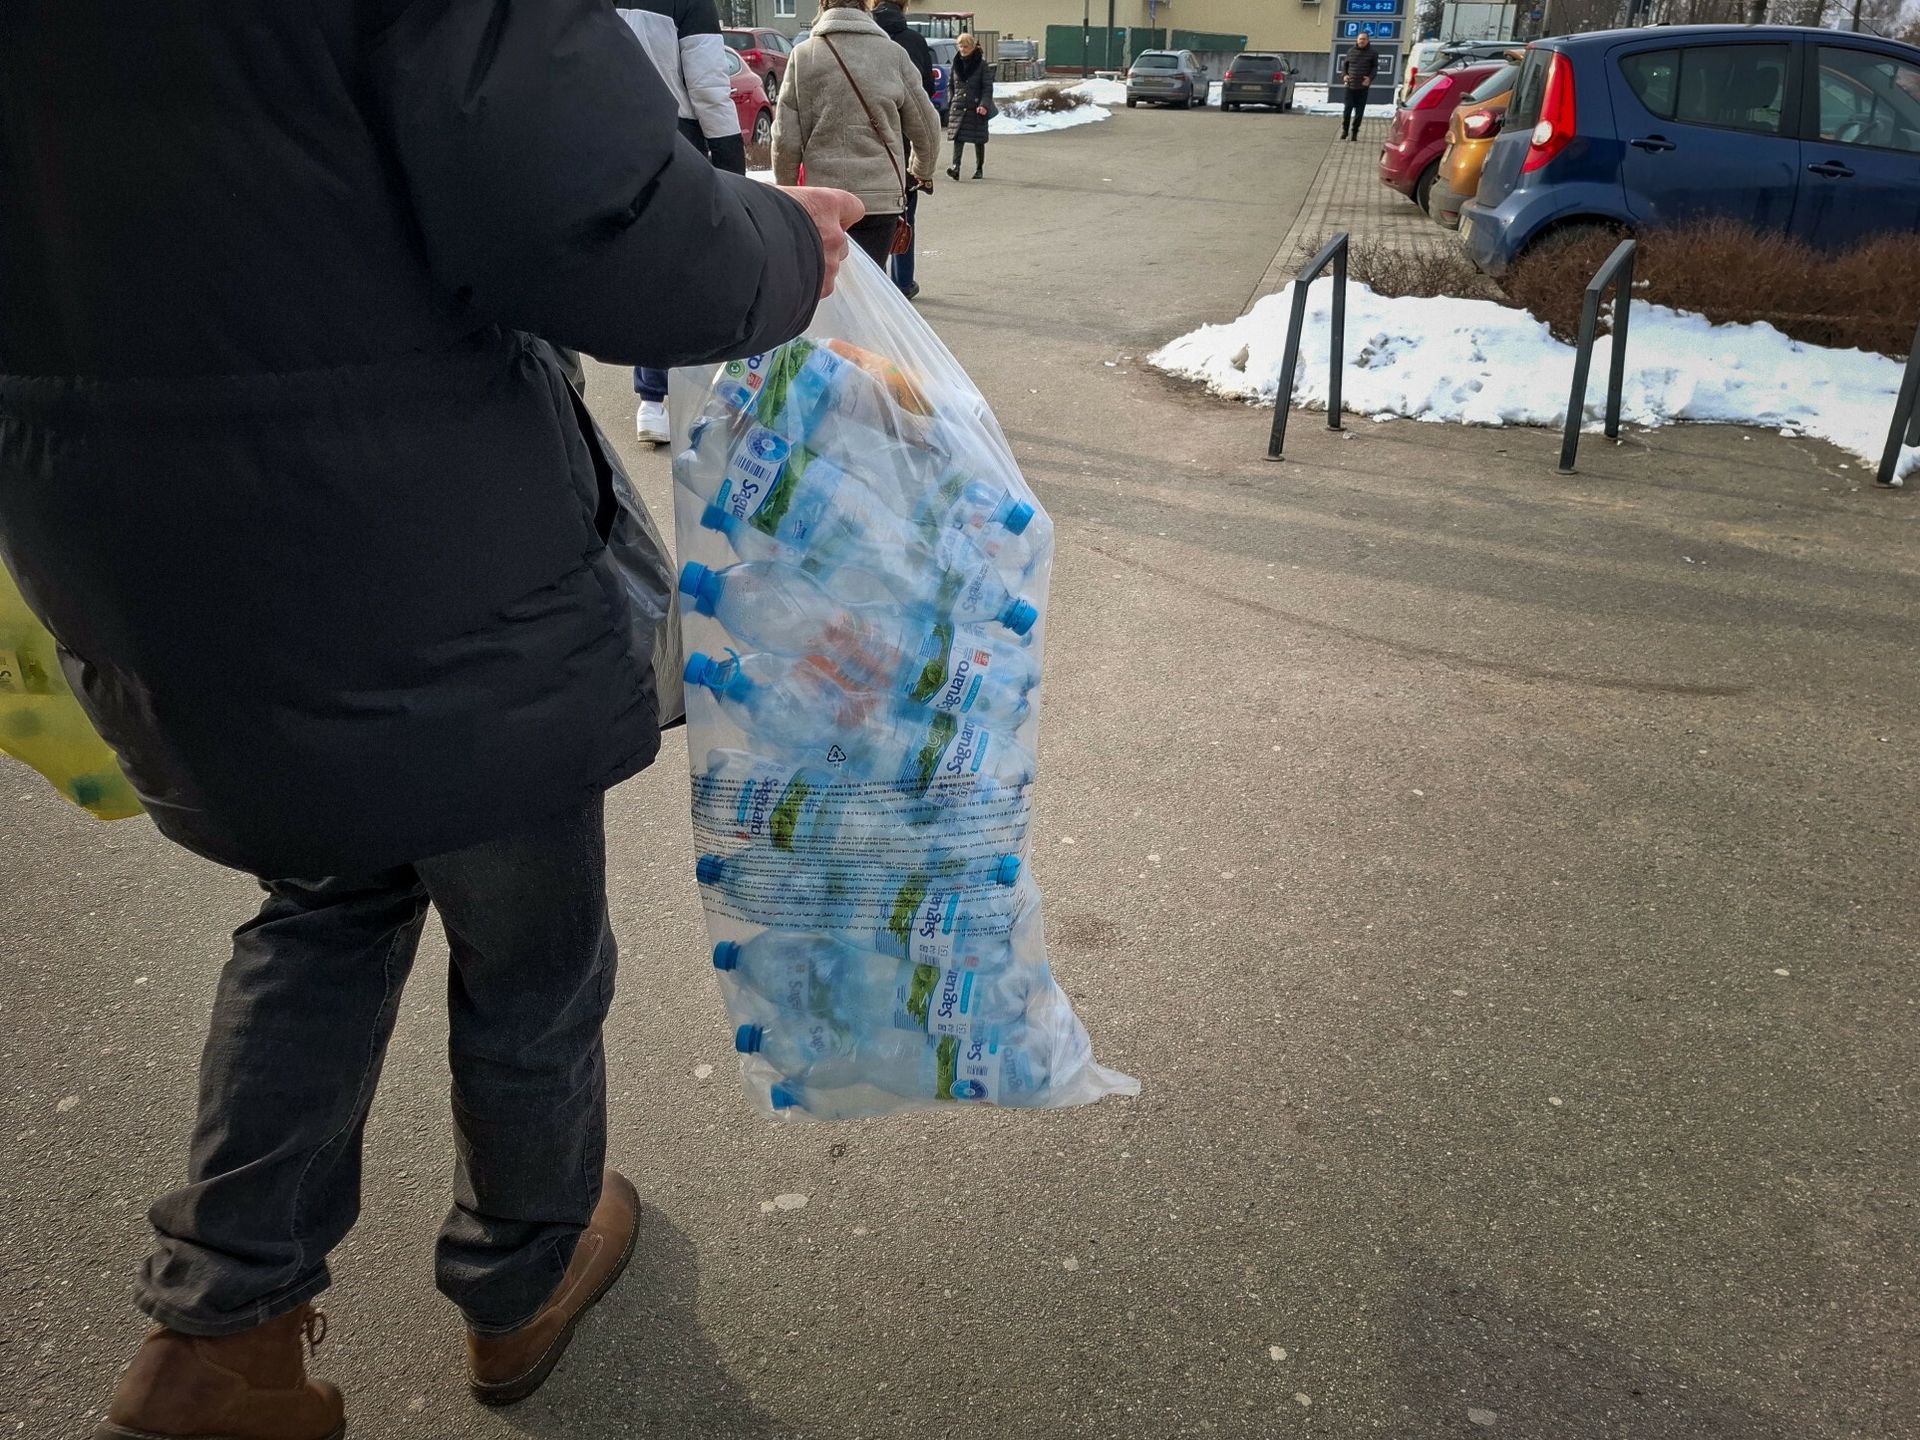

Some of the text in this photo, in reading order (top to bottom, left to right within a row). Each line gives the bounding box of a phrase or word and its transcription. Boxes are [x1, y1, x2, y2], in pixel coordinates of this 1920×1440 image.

[1348, 23, 1357, 35] P
[936, 660, 970, 711] Saguaro
[751, 776, 779, 836] Saguaro
[937, 969, 958, 1019] Saguar
